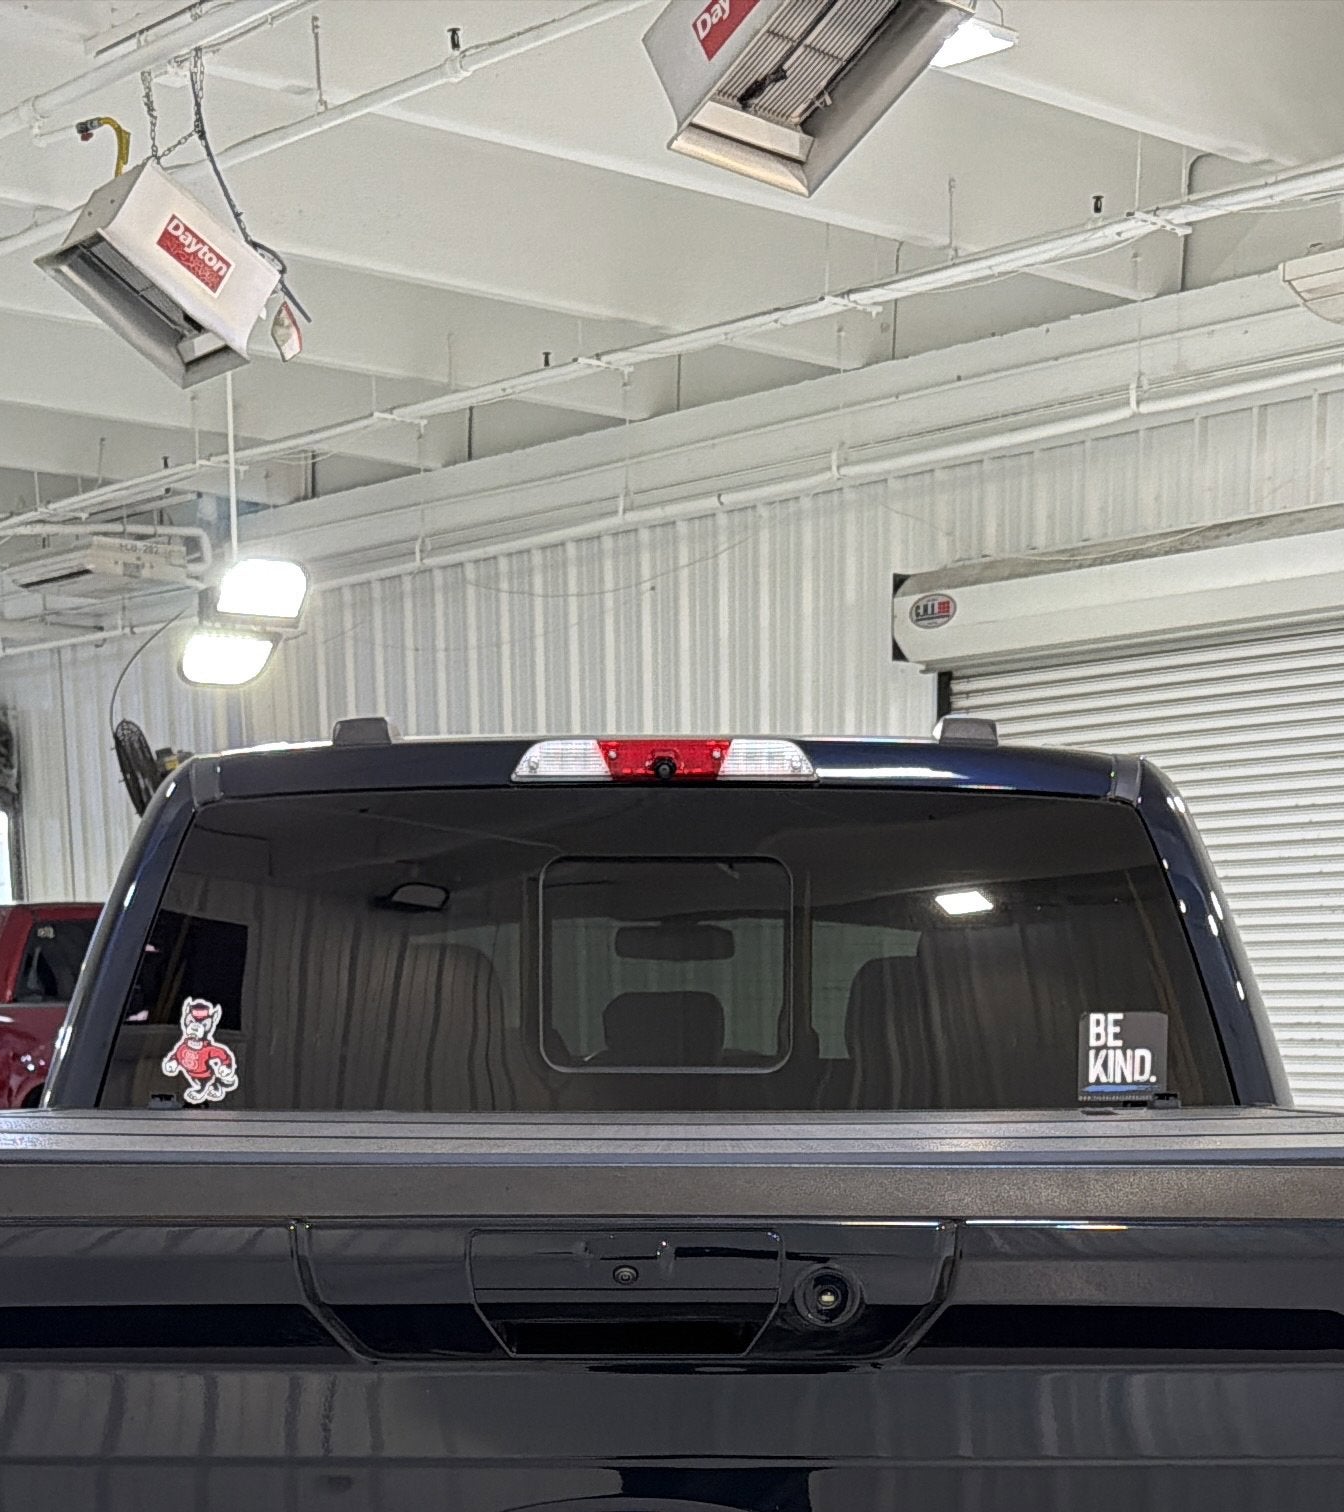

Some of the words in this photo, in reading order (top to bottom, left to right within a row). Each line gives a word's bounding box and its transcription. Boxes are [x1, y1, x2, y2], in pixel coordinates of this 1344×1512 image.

[167, 218, 227, 276] Dayton
[1089, 1012, 1124, 1047] BE
[1089, 1048, 1157, 1084] KIND.
